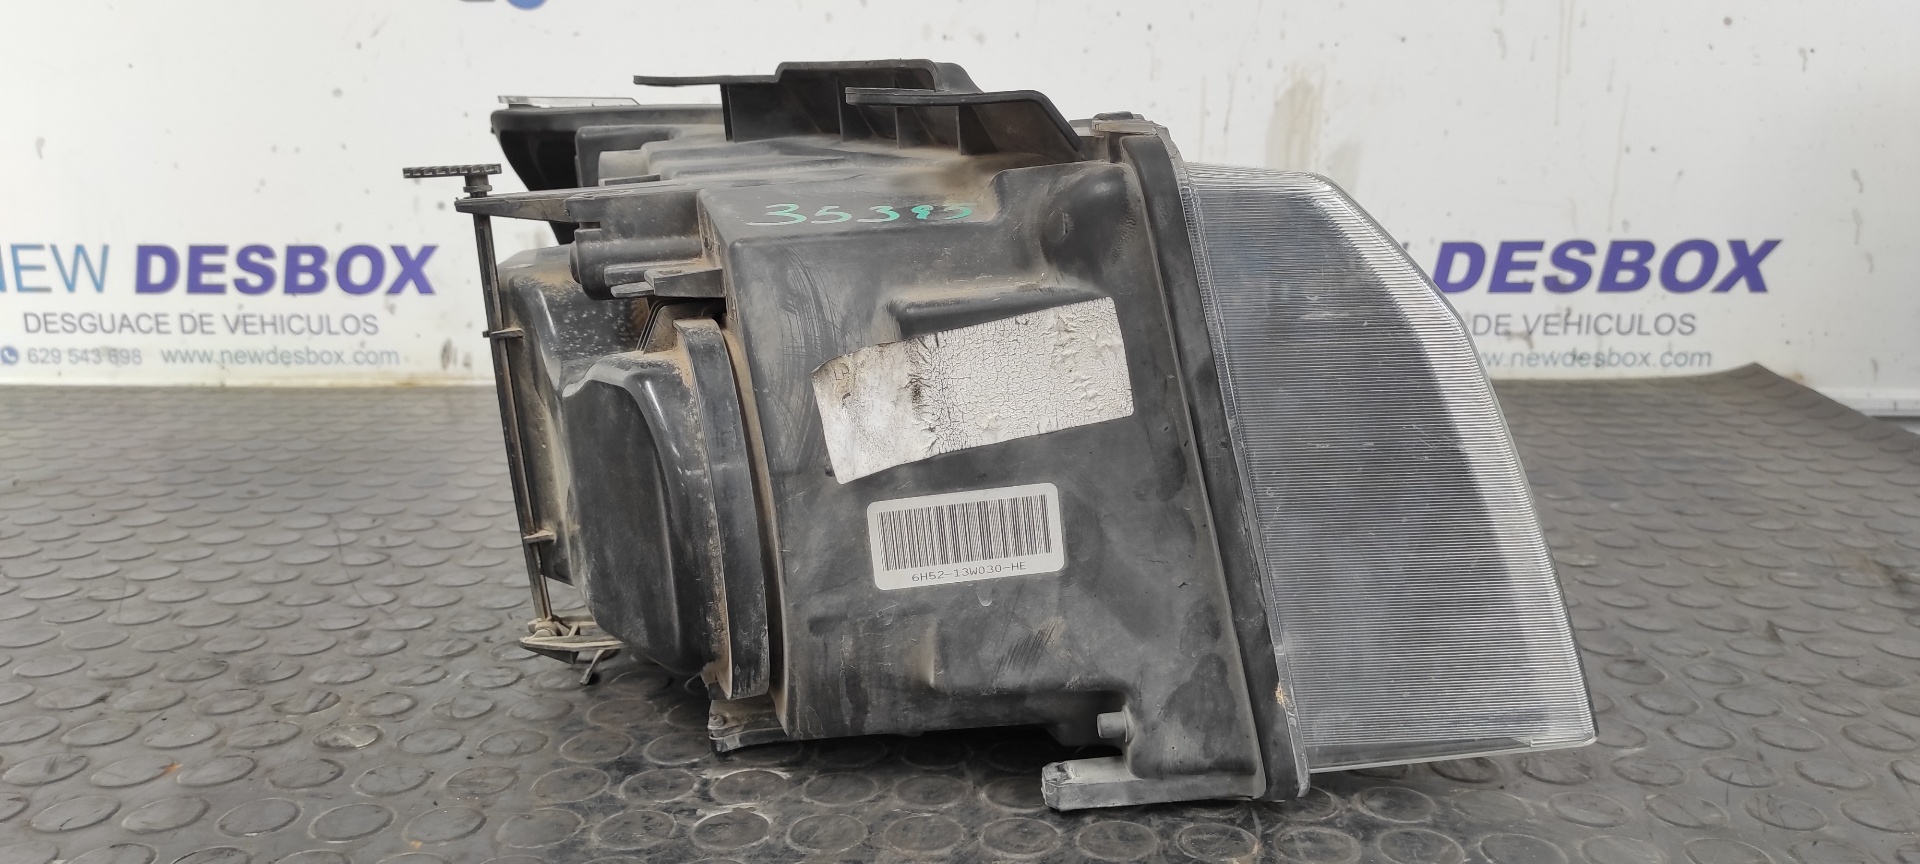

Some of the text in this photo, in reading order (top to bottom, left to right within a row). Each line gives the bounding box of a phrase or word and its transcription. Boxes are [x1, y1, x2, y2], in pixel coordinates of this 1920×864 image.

[134, 244, 438, 296] DESBOX
[1432, 239, 1783, 295] DESBOX
[23, 312, 380, 336] DESGUACE DE VEHICULOS
[1472, 312, 1697, 336] DE VEHICULOS
[26, 345, 400, 367] 629 543 698 www.newdesbox.com
[911, 560, 1027, 583] 6H52-13W030-HE
